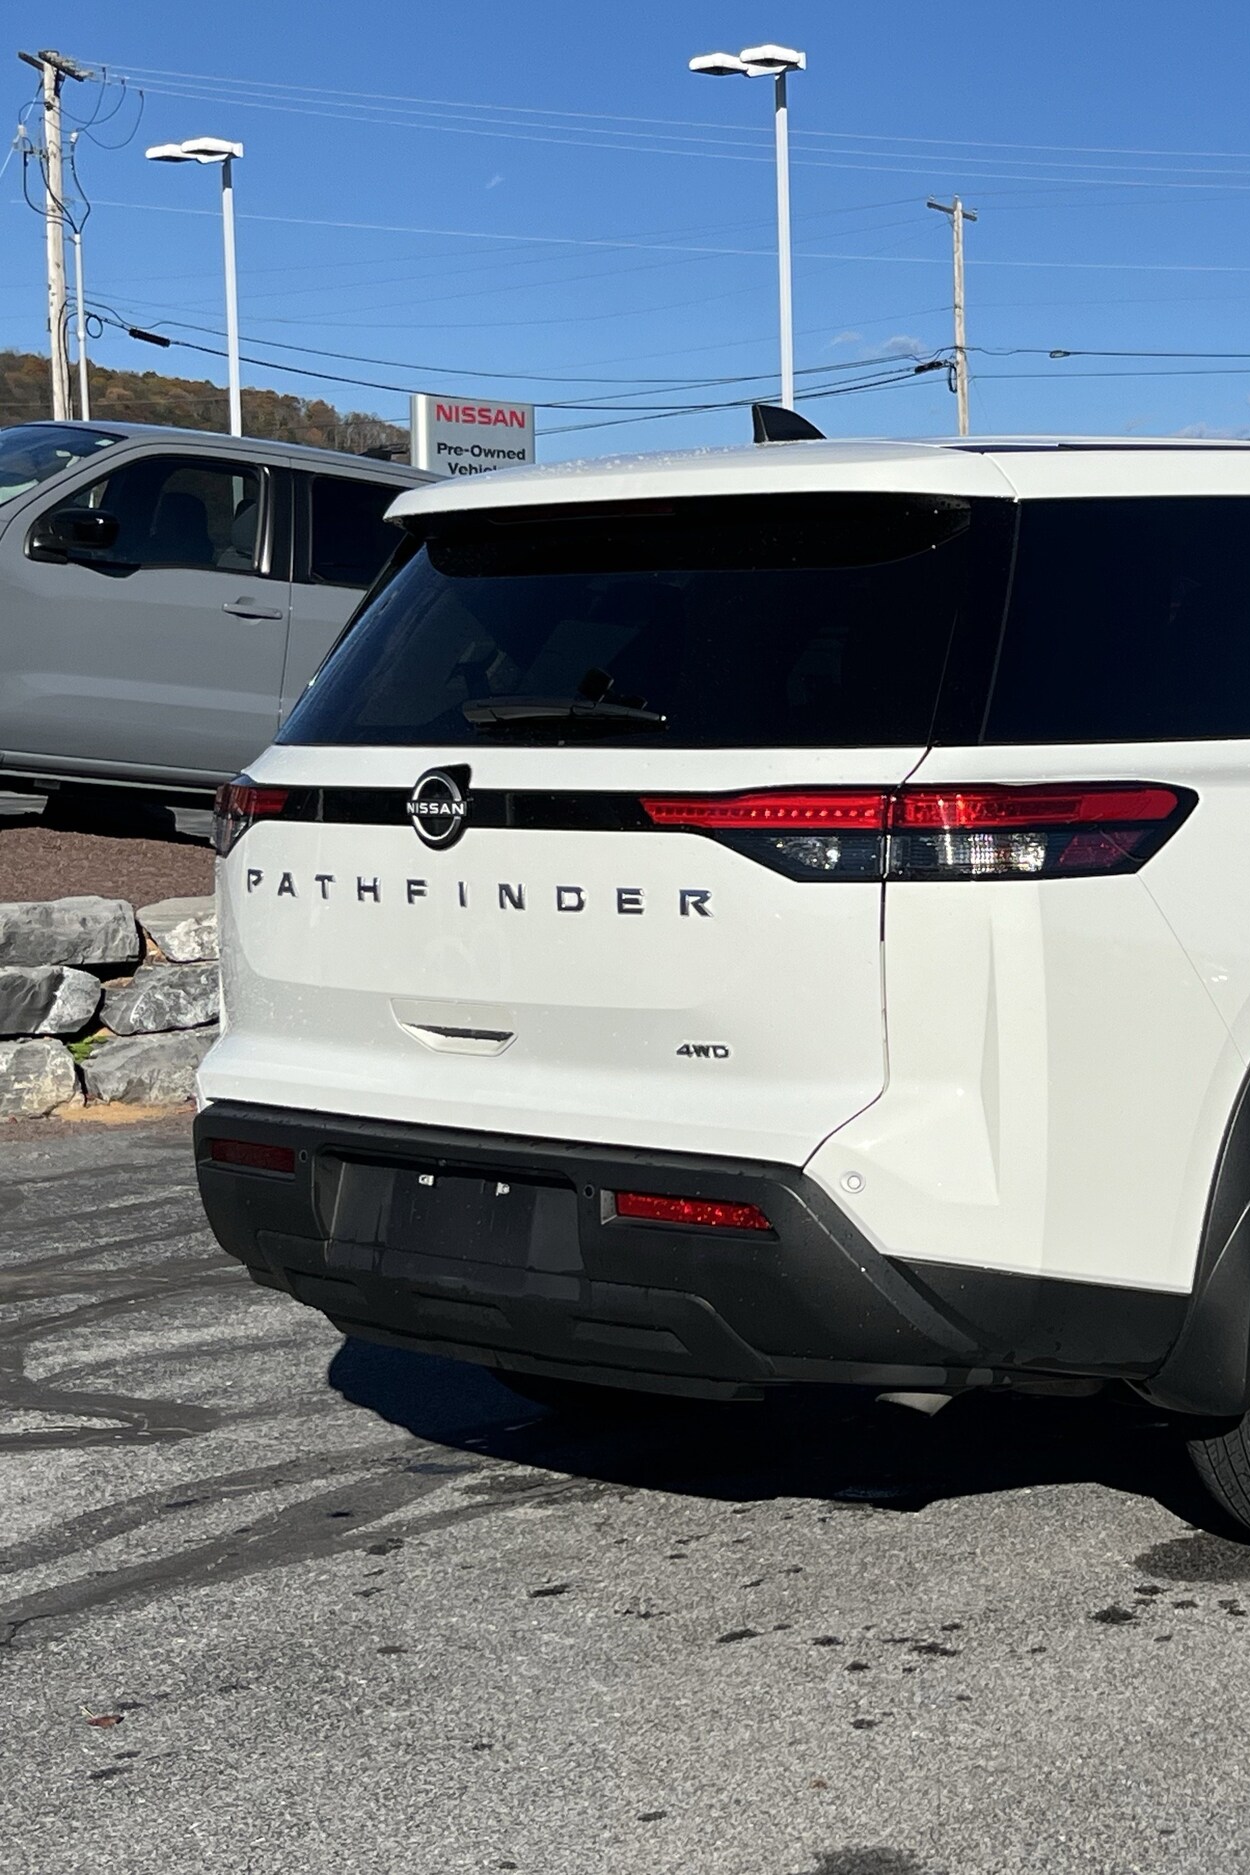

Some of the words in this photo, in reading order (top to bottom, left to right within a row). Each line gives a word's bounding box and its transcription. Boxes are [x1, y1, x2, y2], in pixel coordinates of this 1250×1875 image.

[435, 404, 526, 429] NISSAN
[436, 442, 526, 461] Pre-Owned
[406, 802, 465, 815] NISSAN
[247, 868, 714, 918] PATHFINDER
[676, 1043, 730, 1059] 4WD
